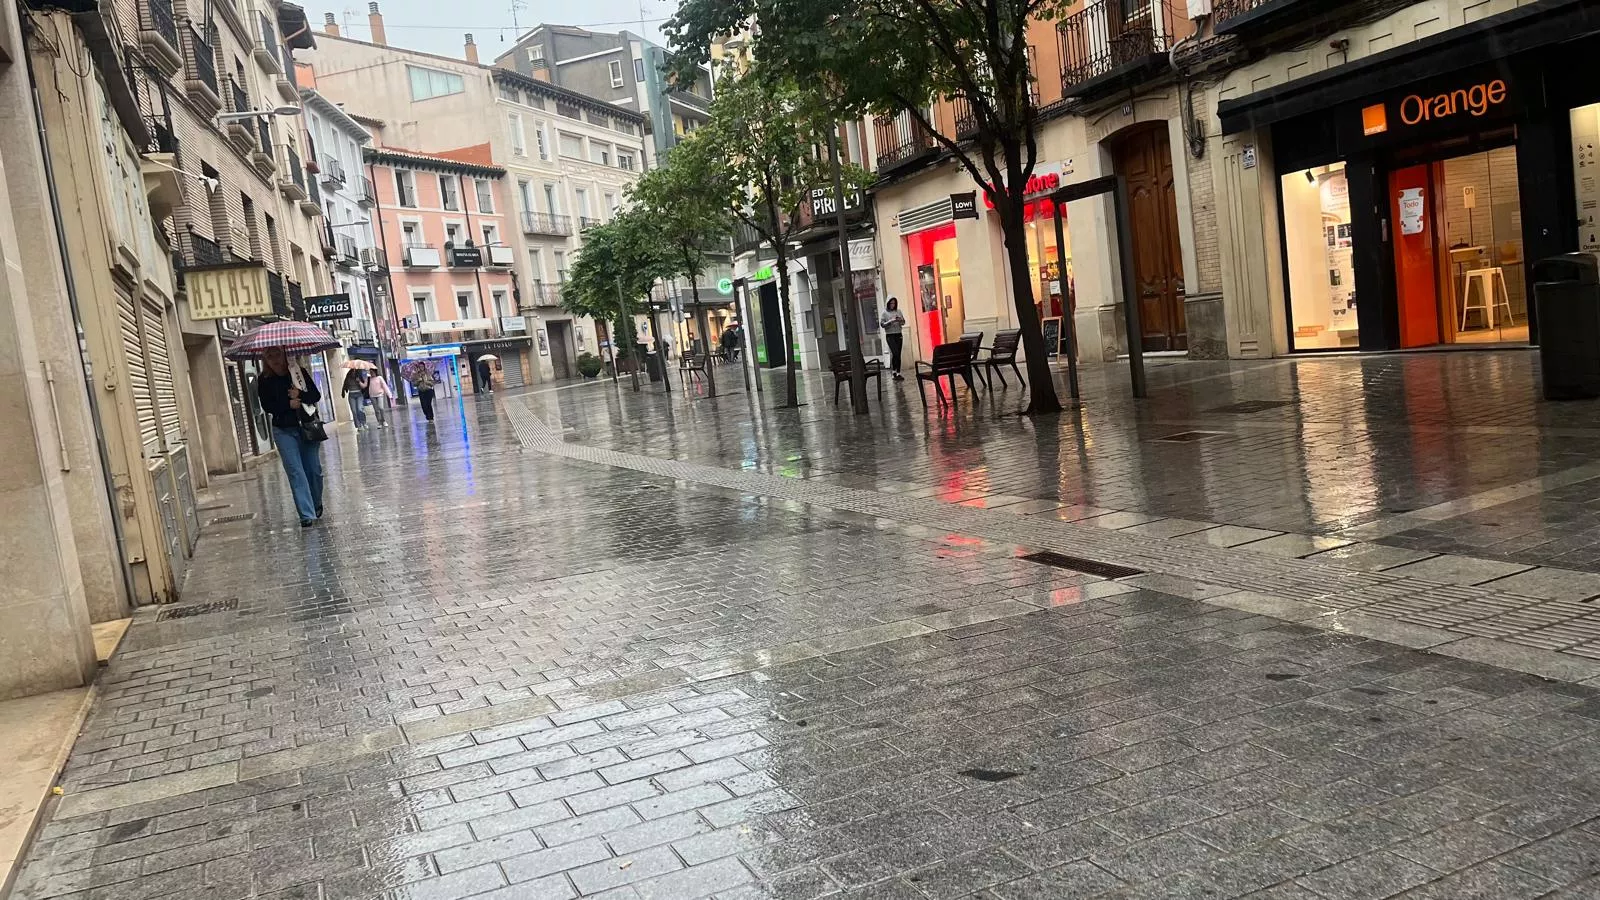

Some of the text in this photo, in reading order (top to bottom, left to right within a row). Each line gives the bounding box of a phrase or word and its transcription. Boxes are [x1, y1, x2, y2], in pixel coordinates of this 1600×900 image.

[1400, 79, 1506, 125] Orange
[1403, 201, 1419, 209] Todo
[191, 268, 264, 310] ASCASO
[309, 302, 350, 315] Arenas
